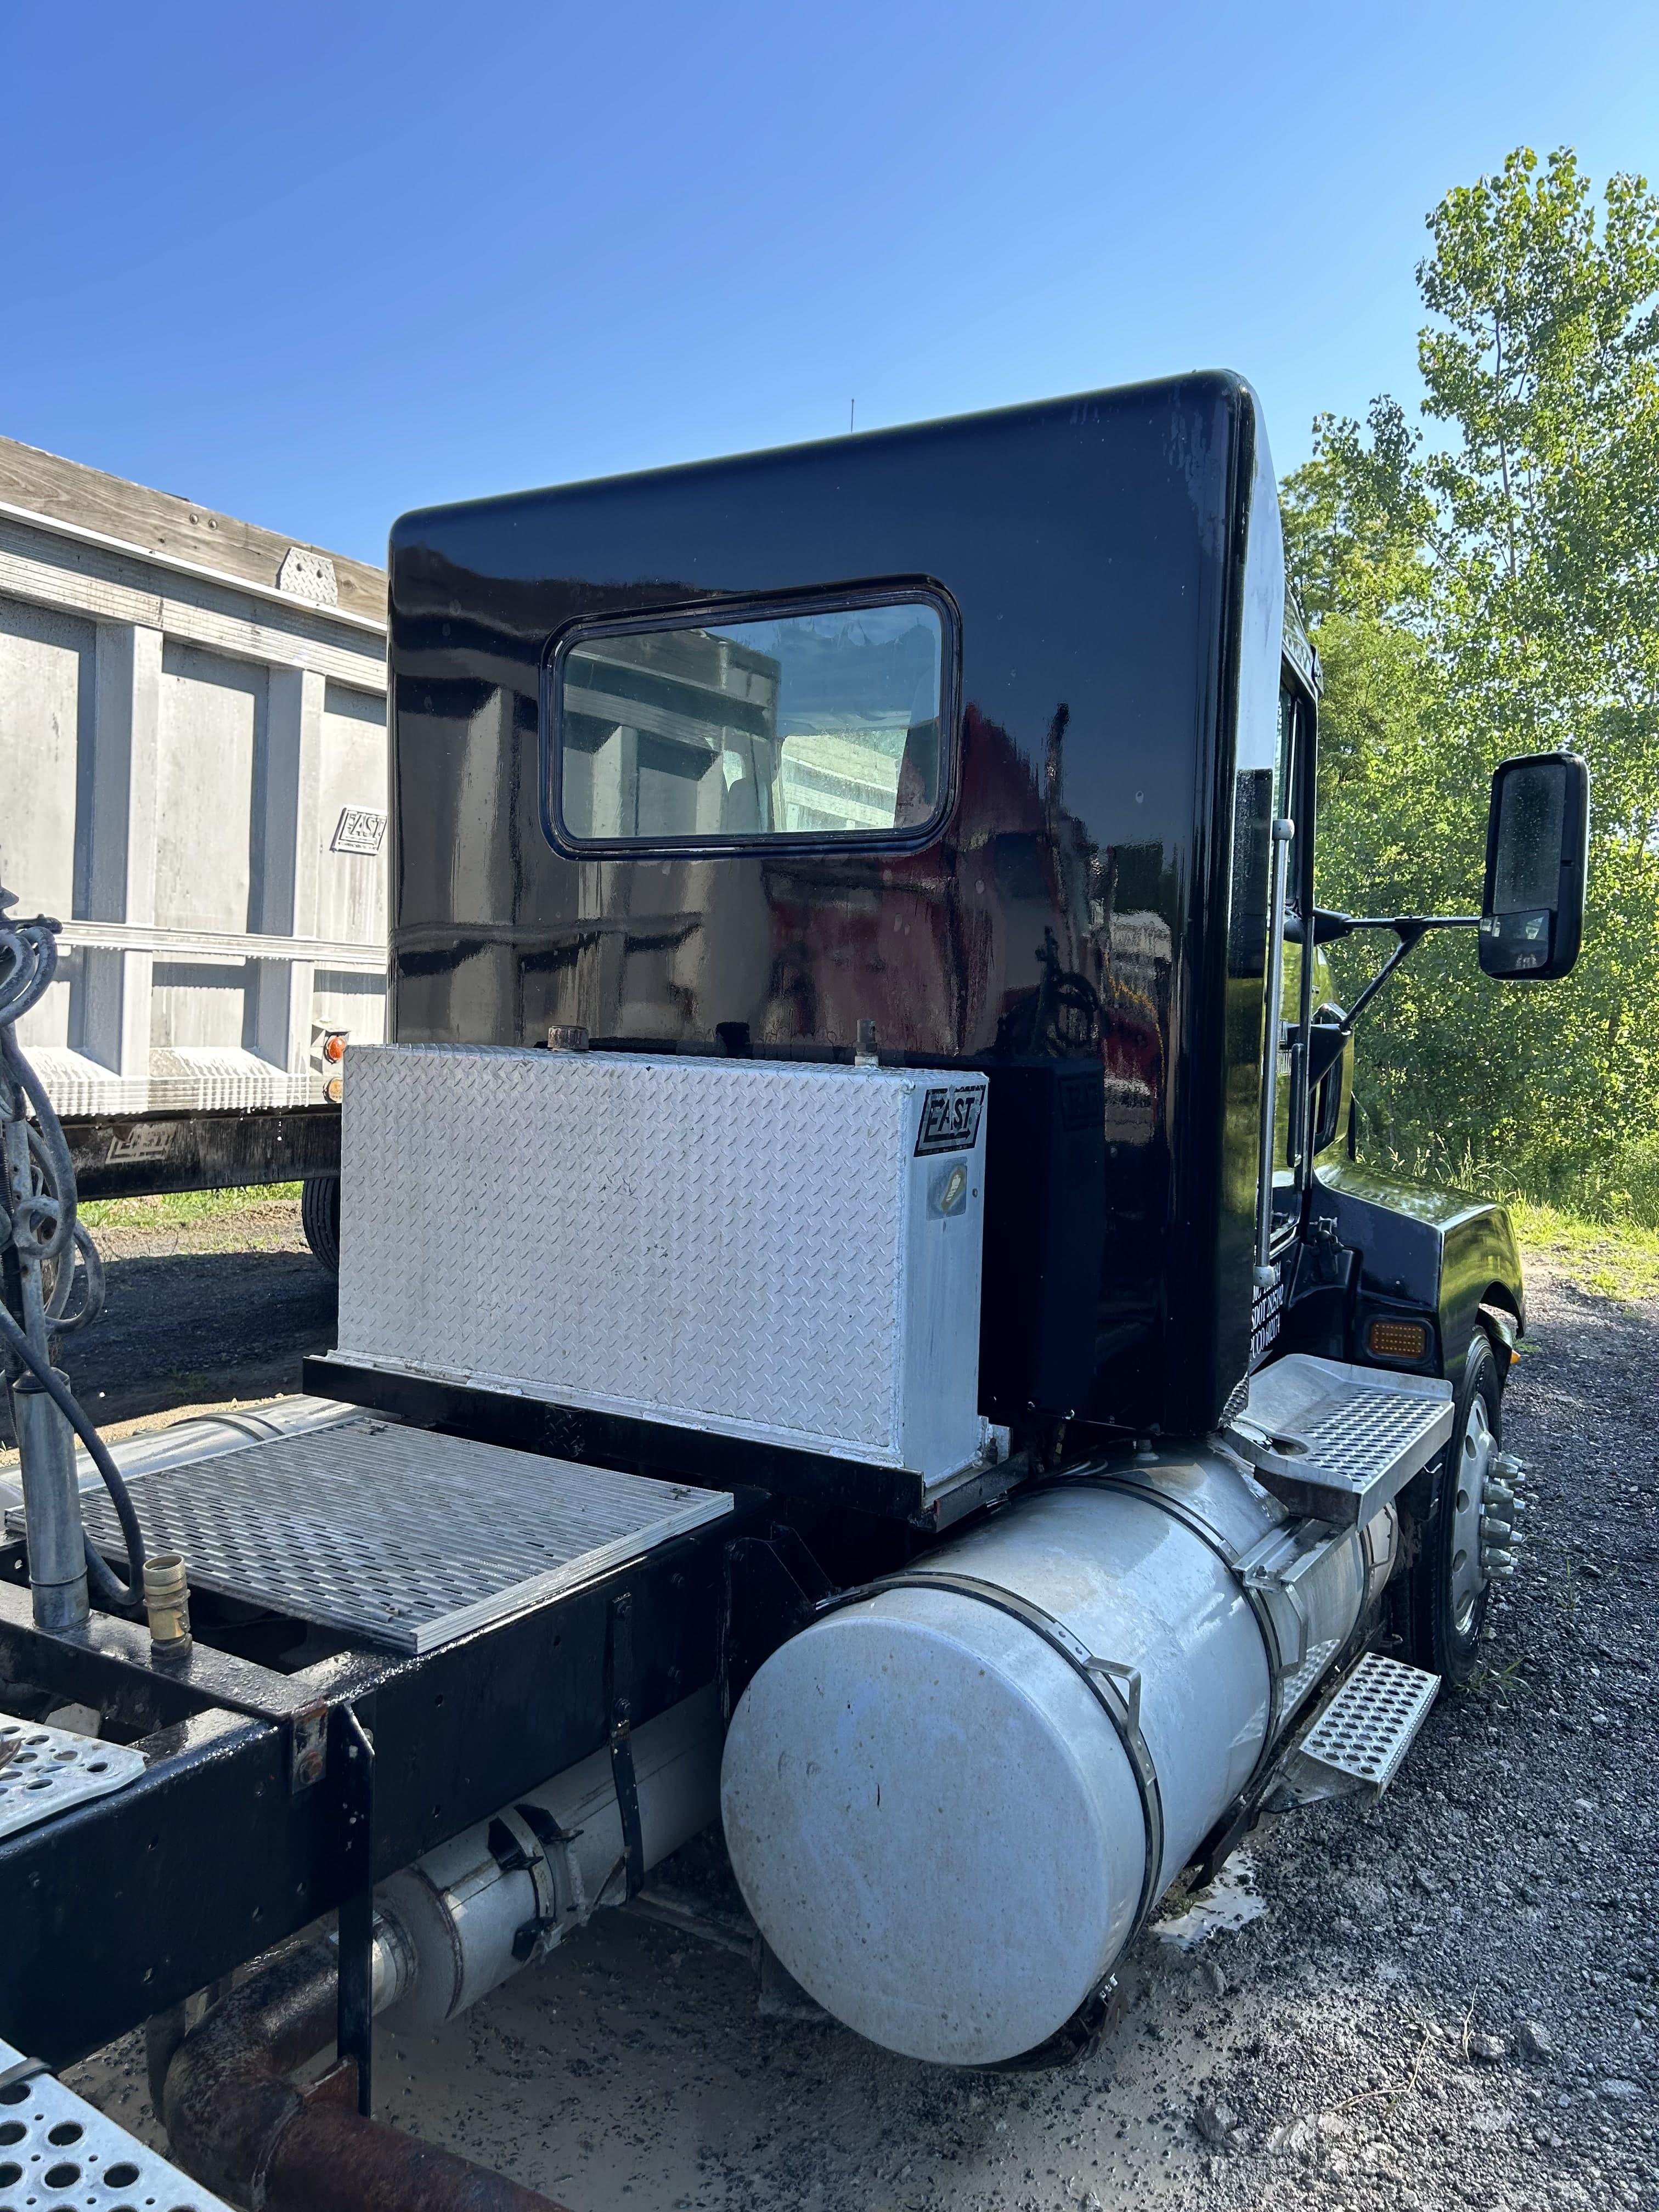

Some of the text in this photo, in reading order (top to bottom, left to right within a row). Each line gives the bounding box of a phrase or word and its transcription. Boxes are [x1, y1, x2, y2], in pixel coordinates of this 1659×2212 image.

[341, 812, 385, 843] EAST
[924, 1097, 975, 1143] EAST
[1251, 1297, 1267, 1332] SDOT
